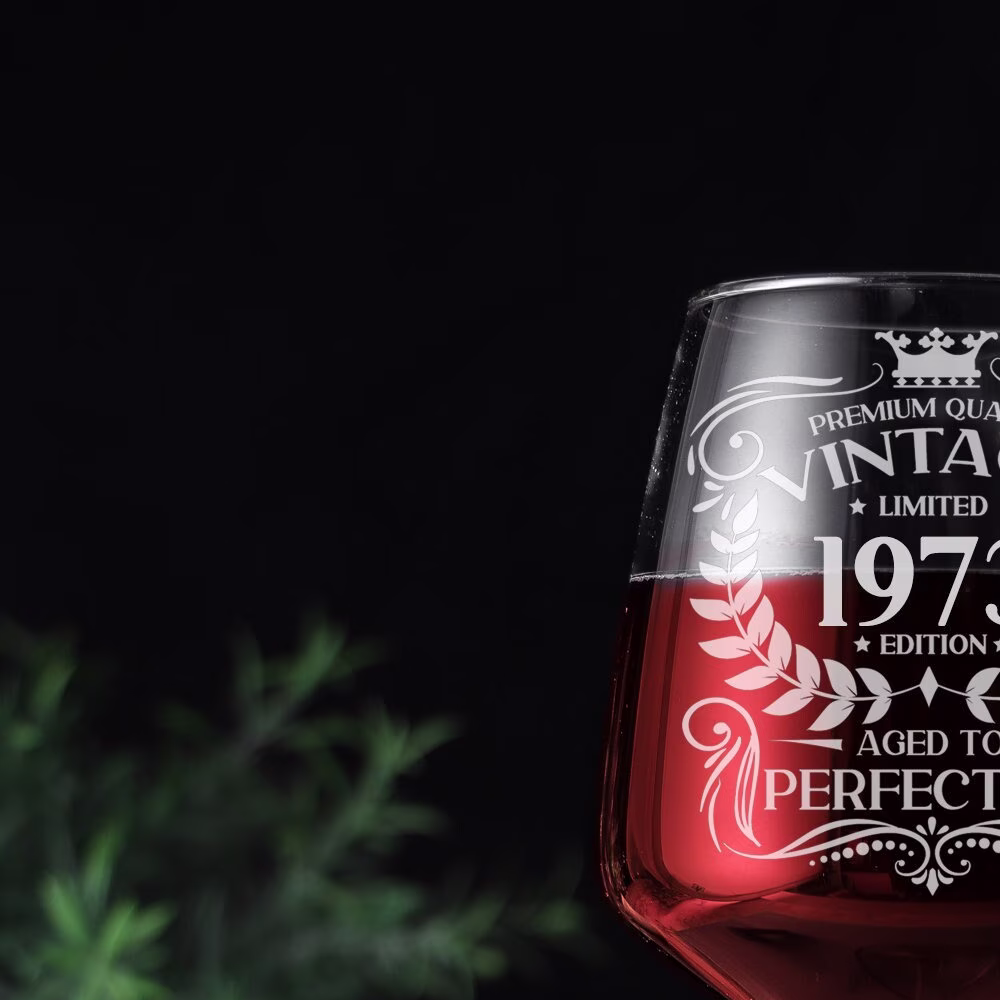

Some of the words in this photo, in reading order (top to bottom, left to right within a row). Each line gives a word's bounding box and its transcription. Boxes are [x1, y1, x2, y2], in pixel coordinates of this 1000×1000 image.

[807, 397, 937, 436] PREMIUM
[879, 495, 988, 517] LIMITED
[879, 633, 988, 655] EDITION
[856, 730, 949, 756] AGED
